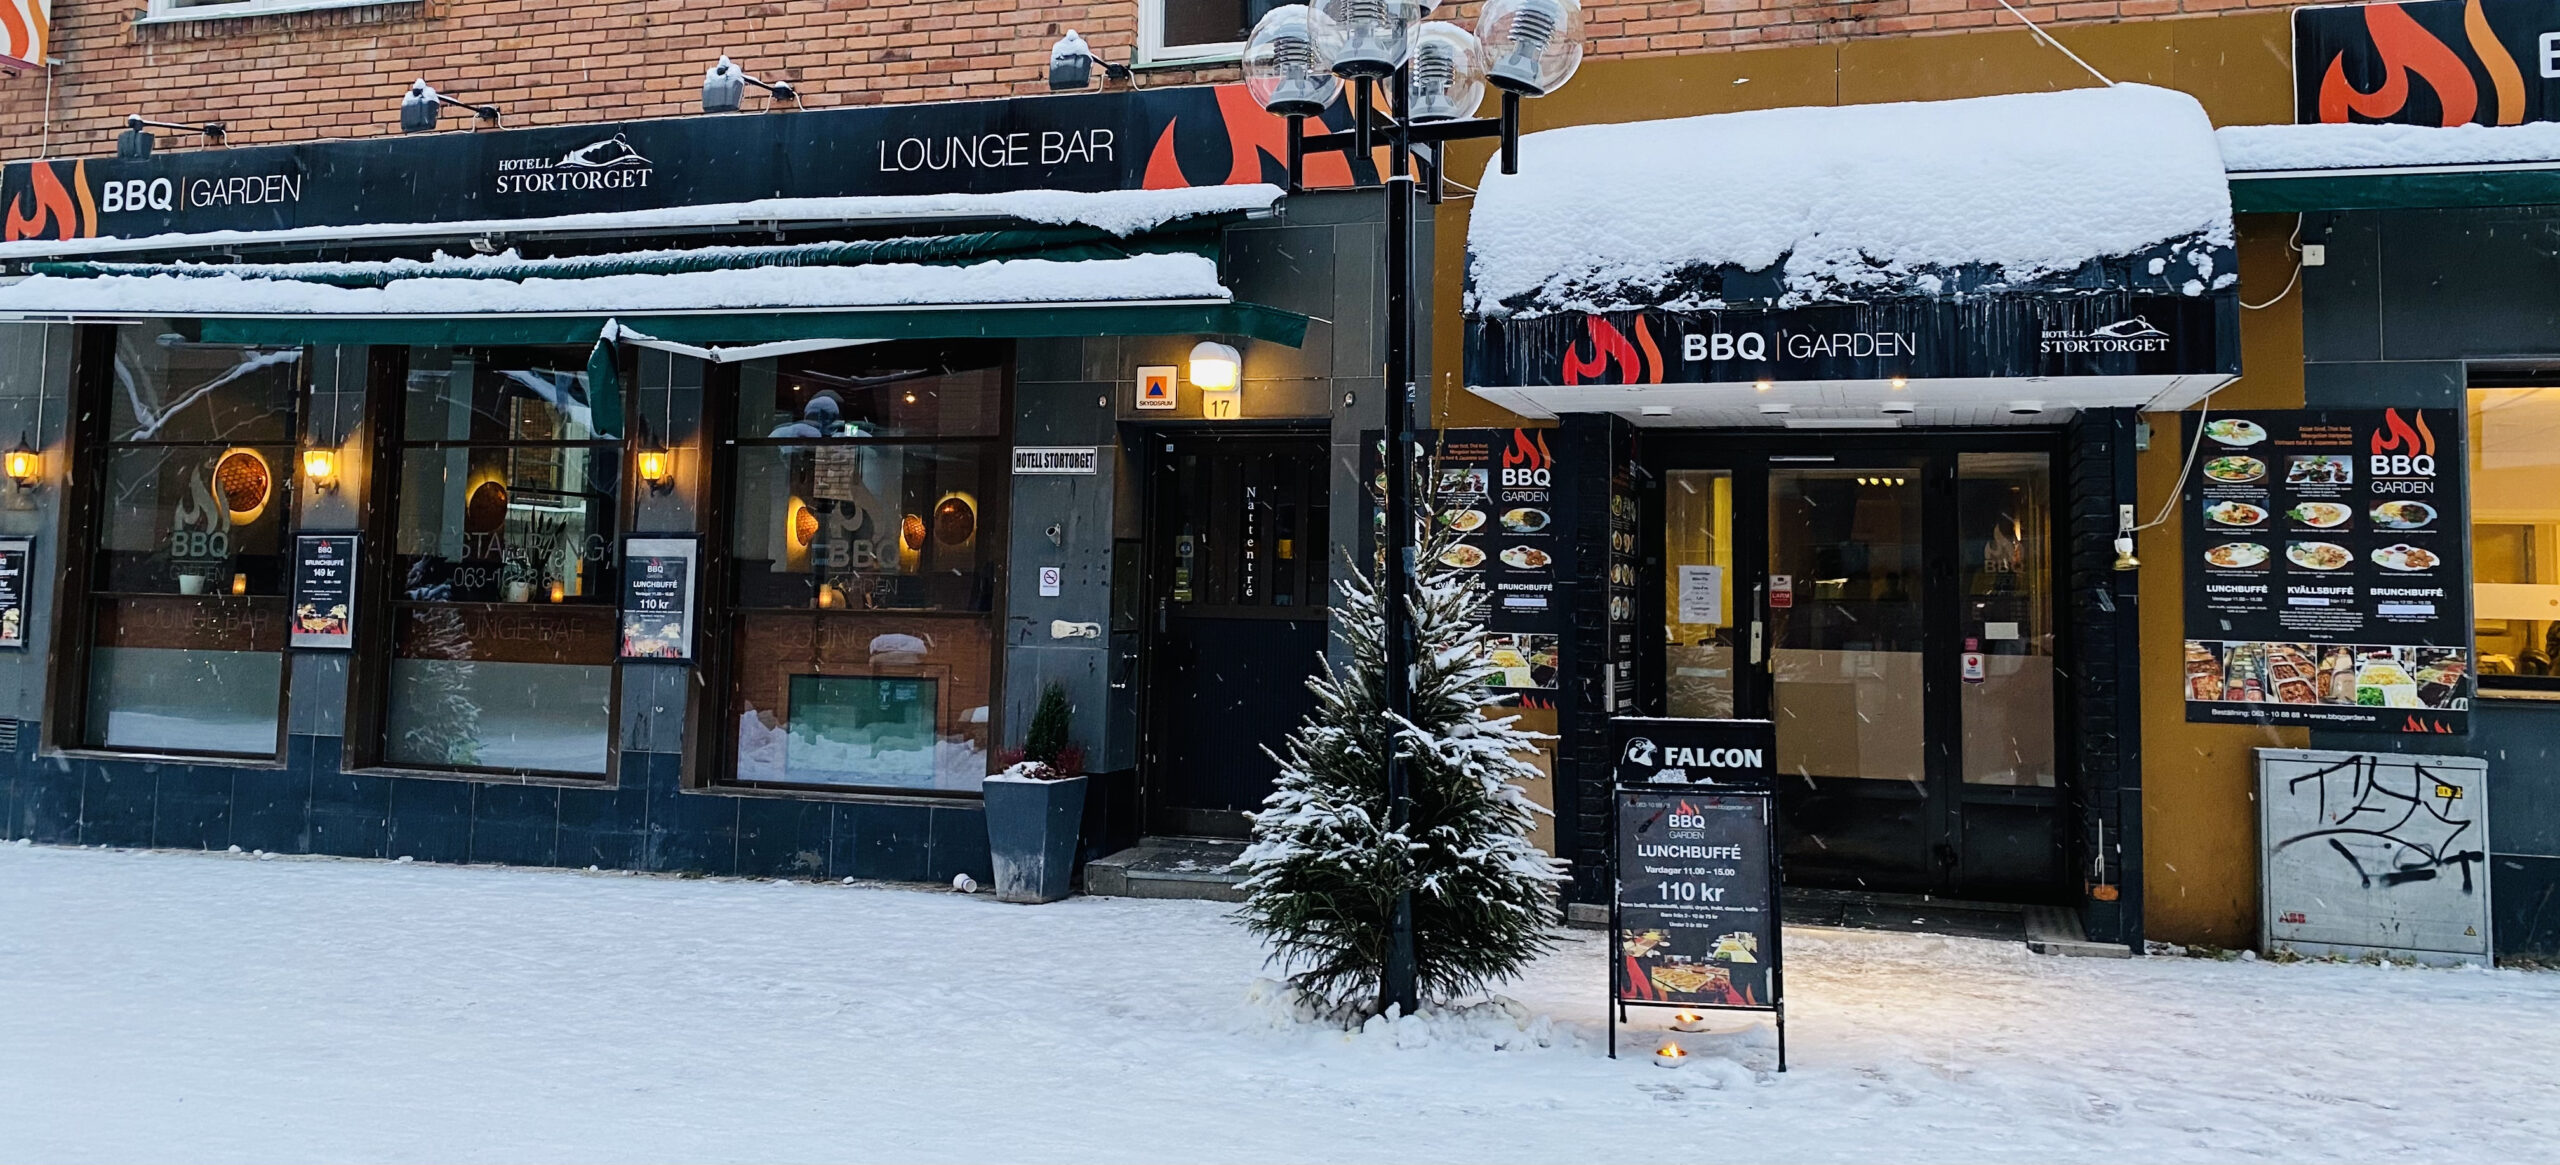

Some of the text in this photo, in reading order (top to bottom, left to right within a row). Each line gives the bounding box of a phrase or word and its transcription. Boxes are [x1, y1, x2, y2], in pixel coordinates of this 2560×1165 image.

[880, 128, 1114, 172] LOUNGE BAR
[498, 157, 554, 171] HOTELL
[496, 168, 653, 194] STORTORGET
[102, 174, 301, 213] BBQ GARDEN
[1684, 331, 1916, 362] BBQ GARDEN
[2040, 338, 2170, 353] STORTORGET
[1211, 400, 1230, 417] 17
[1015, 452, 1094, 469] HOTELL STORTORGET
[2370, 454, 2437, 477] BBQ
[1501, 468, 1551, 488] BBQ
[2371, 481, 2434, 494] GARDEN
[1501, 490, 1550, 502] GARDEN
[170, 530, 231, 560] BBQ
[421, 531, 605, 562] RSTARANG
[1245, 486, 1257, 597] Nattentré
[828, 538, 900, 569] BBQ
[646, 565, 664, 574] BBQ
[633, 580, 678, 589] LUNCHBUFFÉ
[1497, 582, 1553, 592] BRUNCHBUFFÉ
[2206, 584, 2268, 594] LUNCHBUFFÉ
[2287, 585, 2354, 596] KVÄLLSBUFFÉ
[2370, 586, 2444, 598] BRUNCHBUFFÉ
[640, 599, 670, 610] 110 kr
[1664, 747, 1763, 769] FALCON
[1668, 814, 1706, 829] BBQ
[1668, 830, 1705, 839] GARDEN
[1637, 844, 1742, 860] LUNCHBUFFÉ
[1645, 865, 1681, 876] Vardagar
[1683, 867, 1705, 875] 11.00
[1713, 868, 1736, 876] 15.00
[1657, 881, 1725, 902] 110 kr
